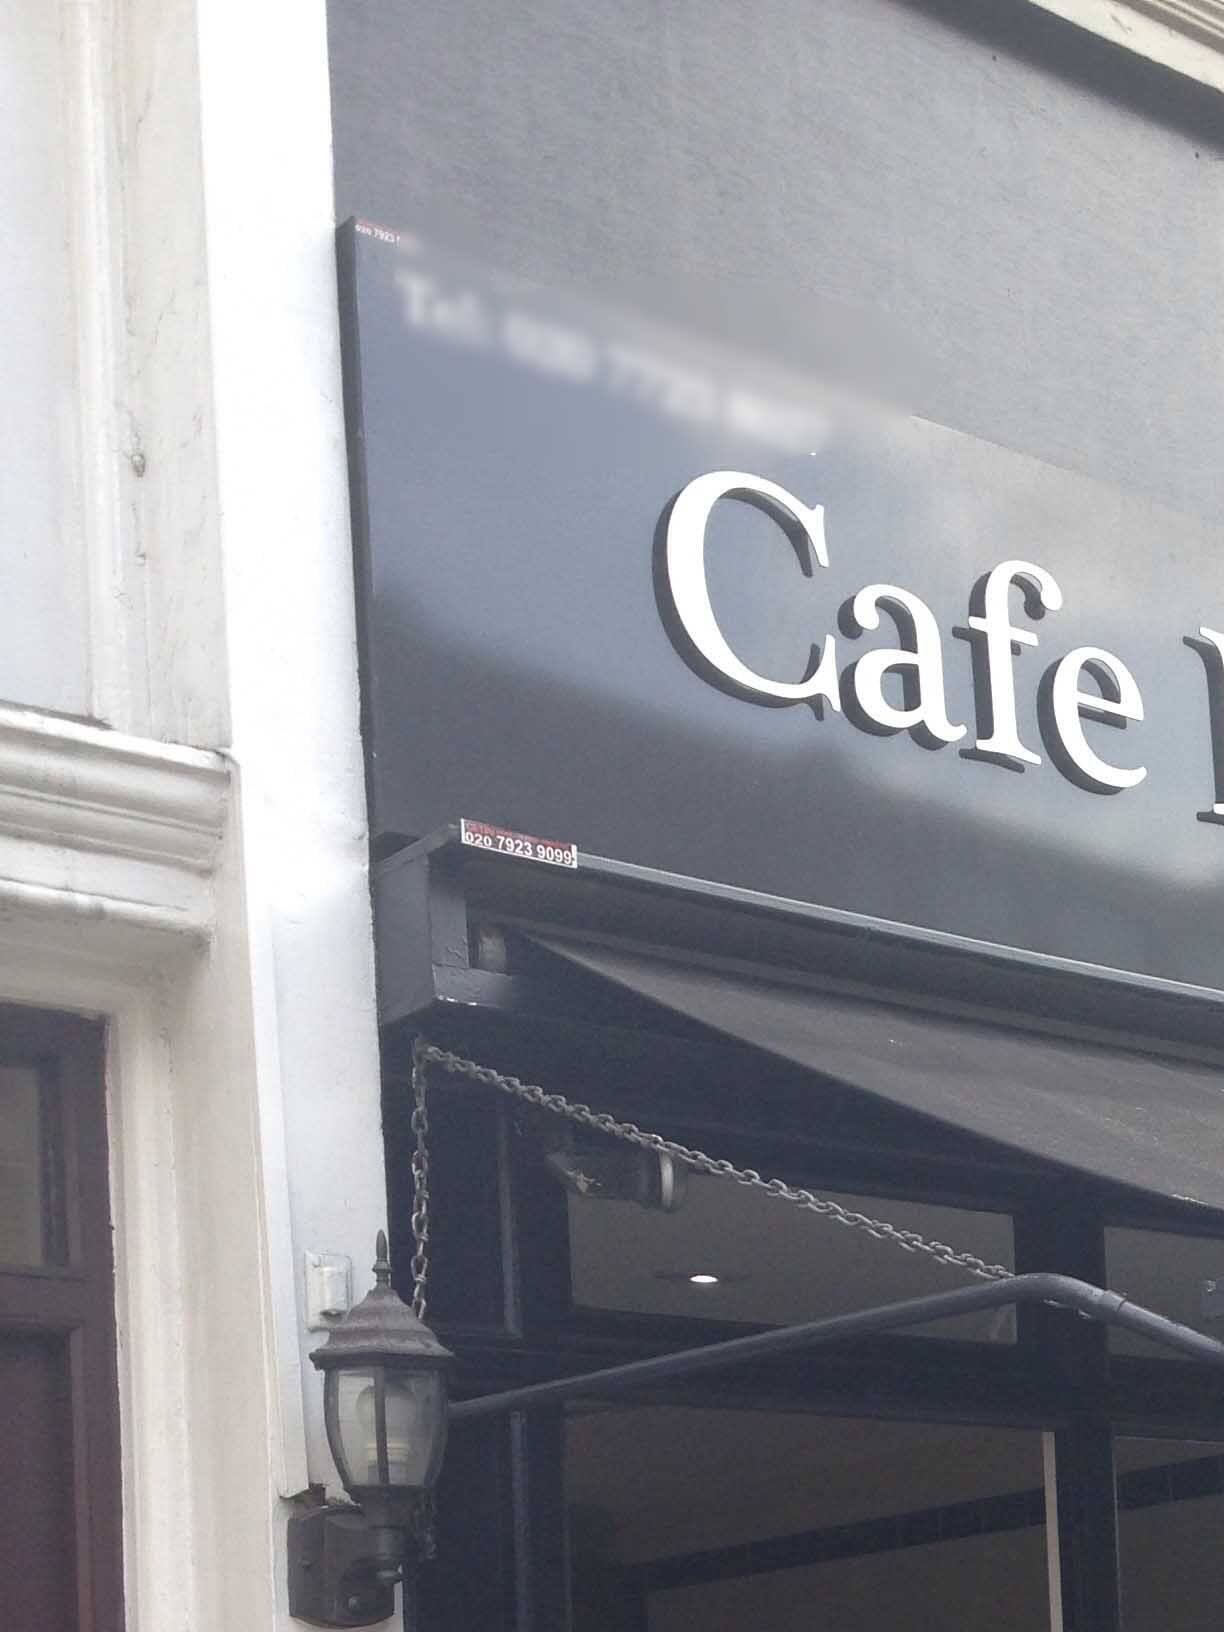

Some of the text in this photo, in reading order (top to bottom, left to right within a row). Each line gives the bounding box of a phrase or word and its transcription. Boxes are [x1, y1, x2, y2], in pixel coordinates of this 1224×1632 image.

[660, 469, 1148, 794] Cafe
[465, 831, 492, 847] 020
[496, 835, 533, 855] 7923
[536, 844, 572, 865] 9099
